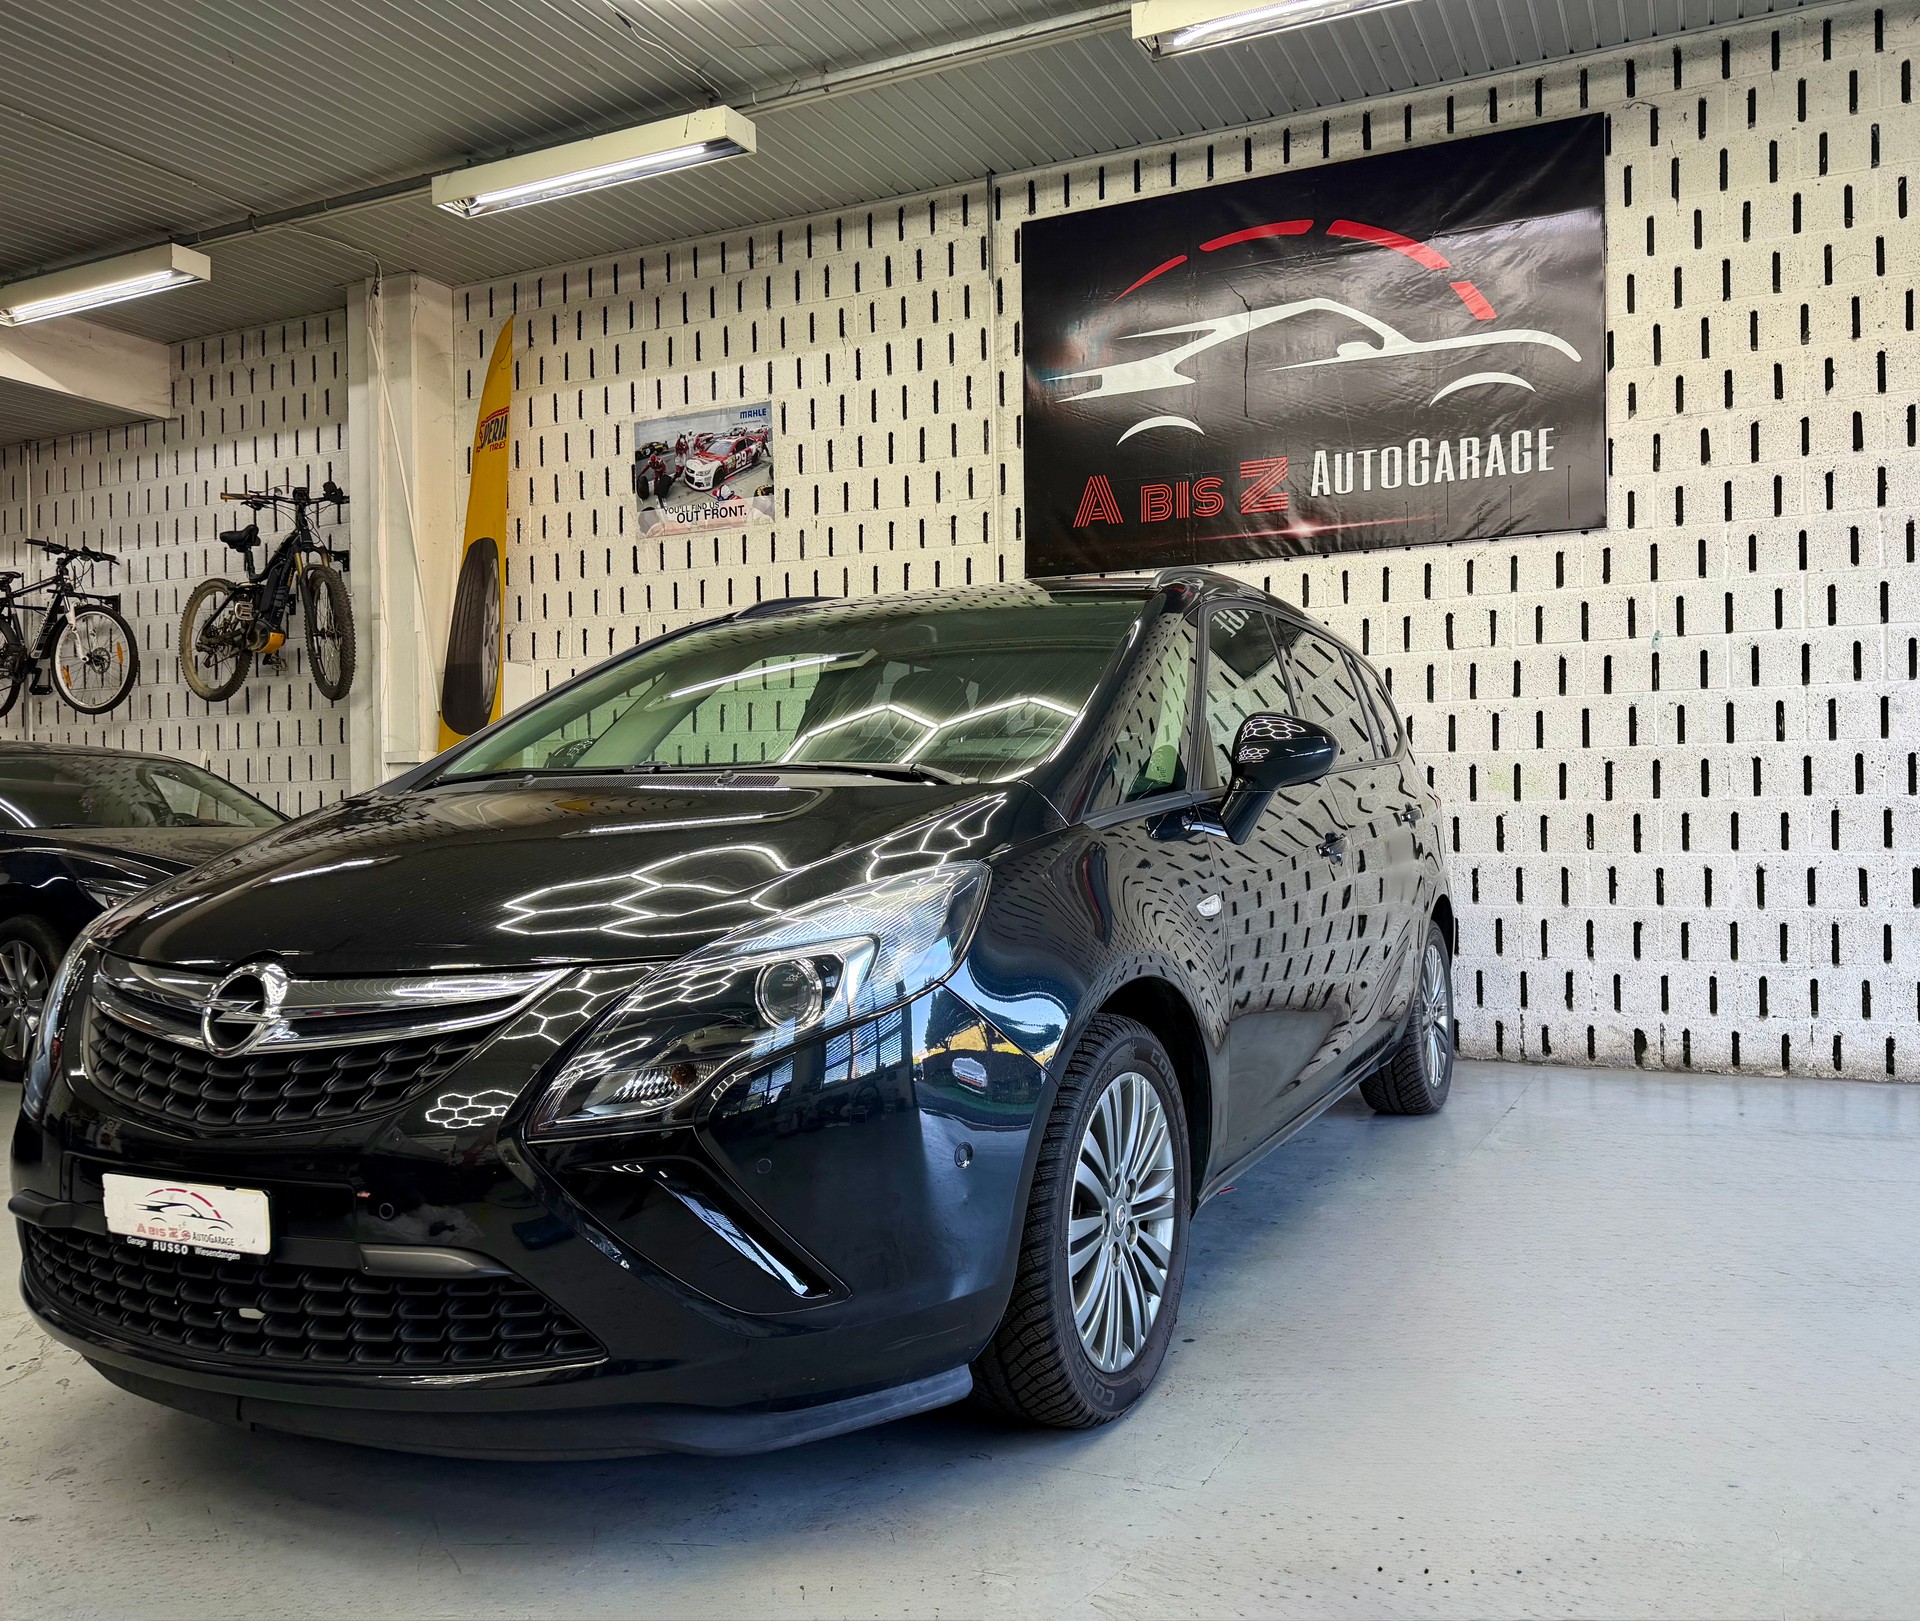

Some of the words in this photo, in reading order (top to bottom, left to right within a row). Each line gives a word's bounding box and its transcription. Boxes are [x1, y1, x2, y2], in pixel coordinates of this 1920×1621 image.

[740, 408, 767, 419] MAHLE
[735, 450, 747, 469] 29
[1073, 474, 1123, 528] A
[1140, 476, 1225, 523] BIS
[1240, 456, 1289, 514] Z
[664, 505, 690, 514] YOU'LL
[692, 502, 707, 513] FIND
[709, 501, 720, 509] US
[677, 510, 700, 523] OUT
[704, 505, 747, 520] FRONT.
[136, 1223, 147, 1234] A
[148, 1227, 166, 1237] BIS
[168, 1227, 179, 1239] Z
[127, 1236, 147, 1248] Garage
[152, 1240, 188, 1255] RUSSO
[194, 1246, 241, 1261] Wiesendangen
